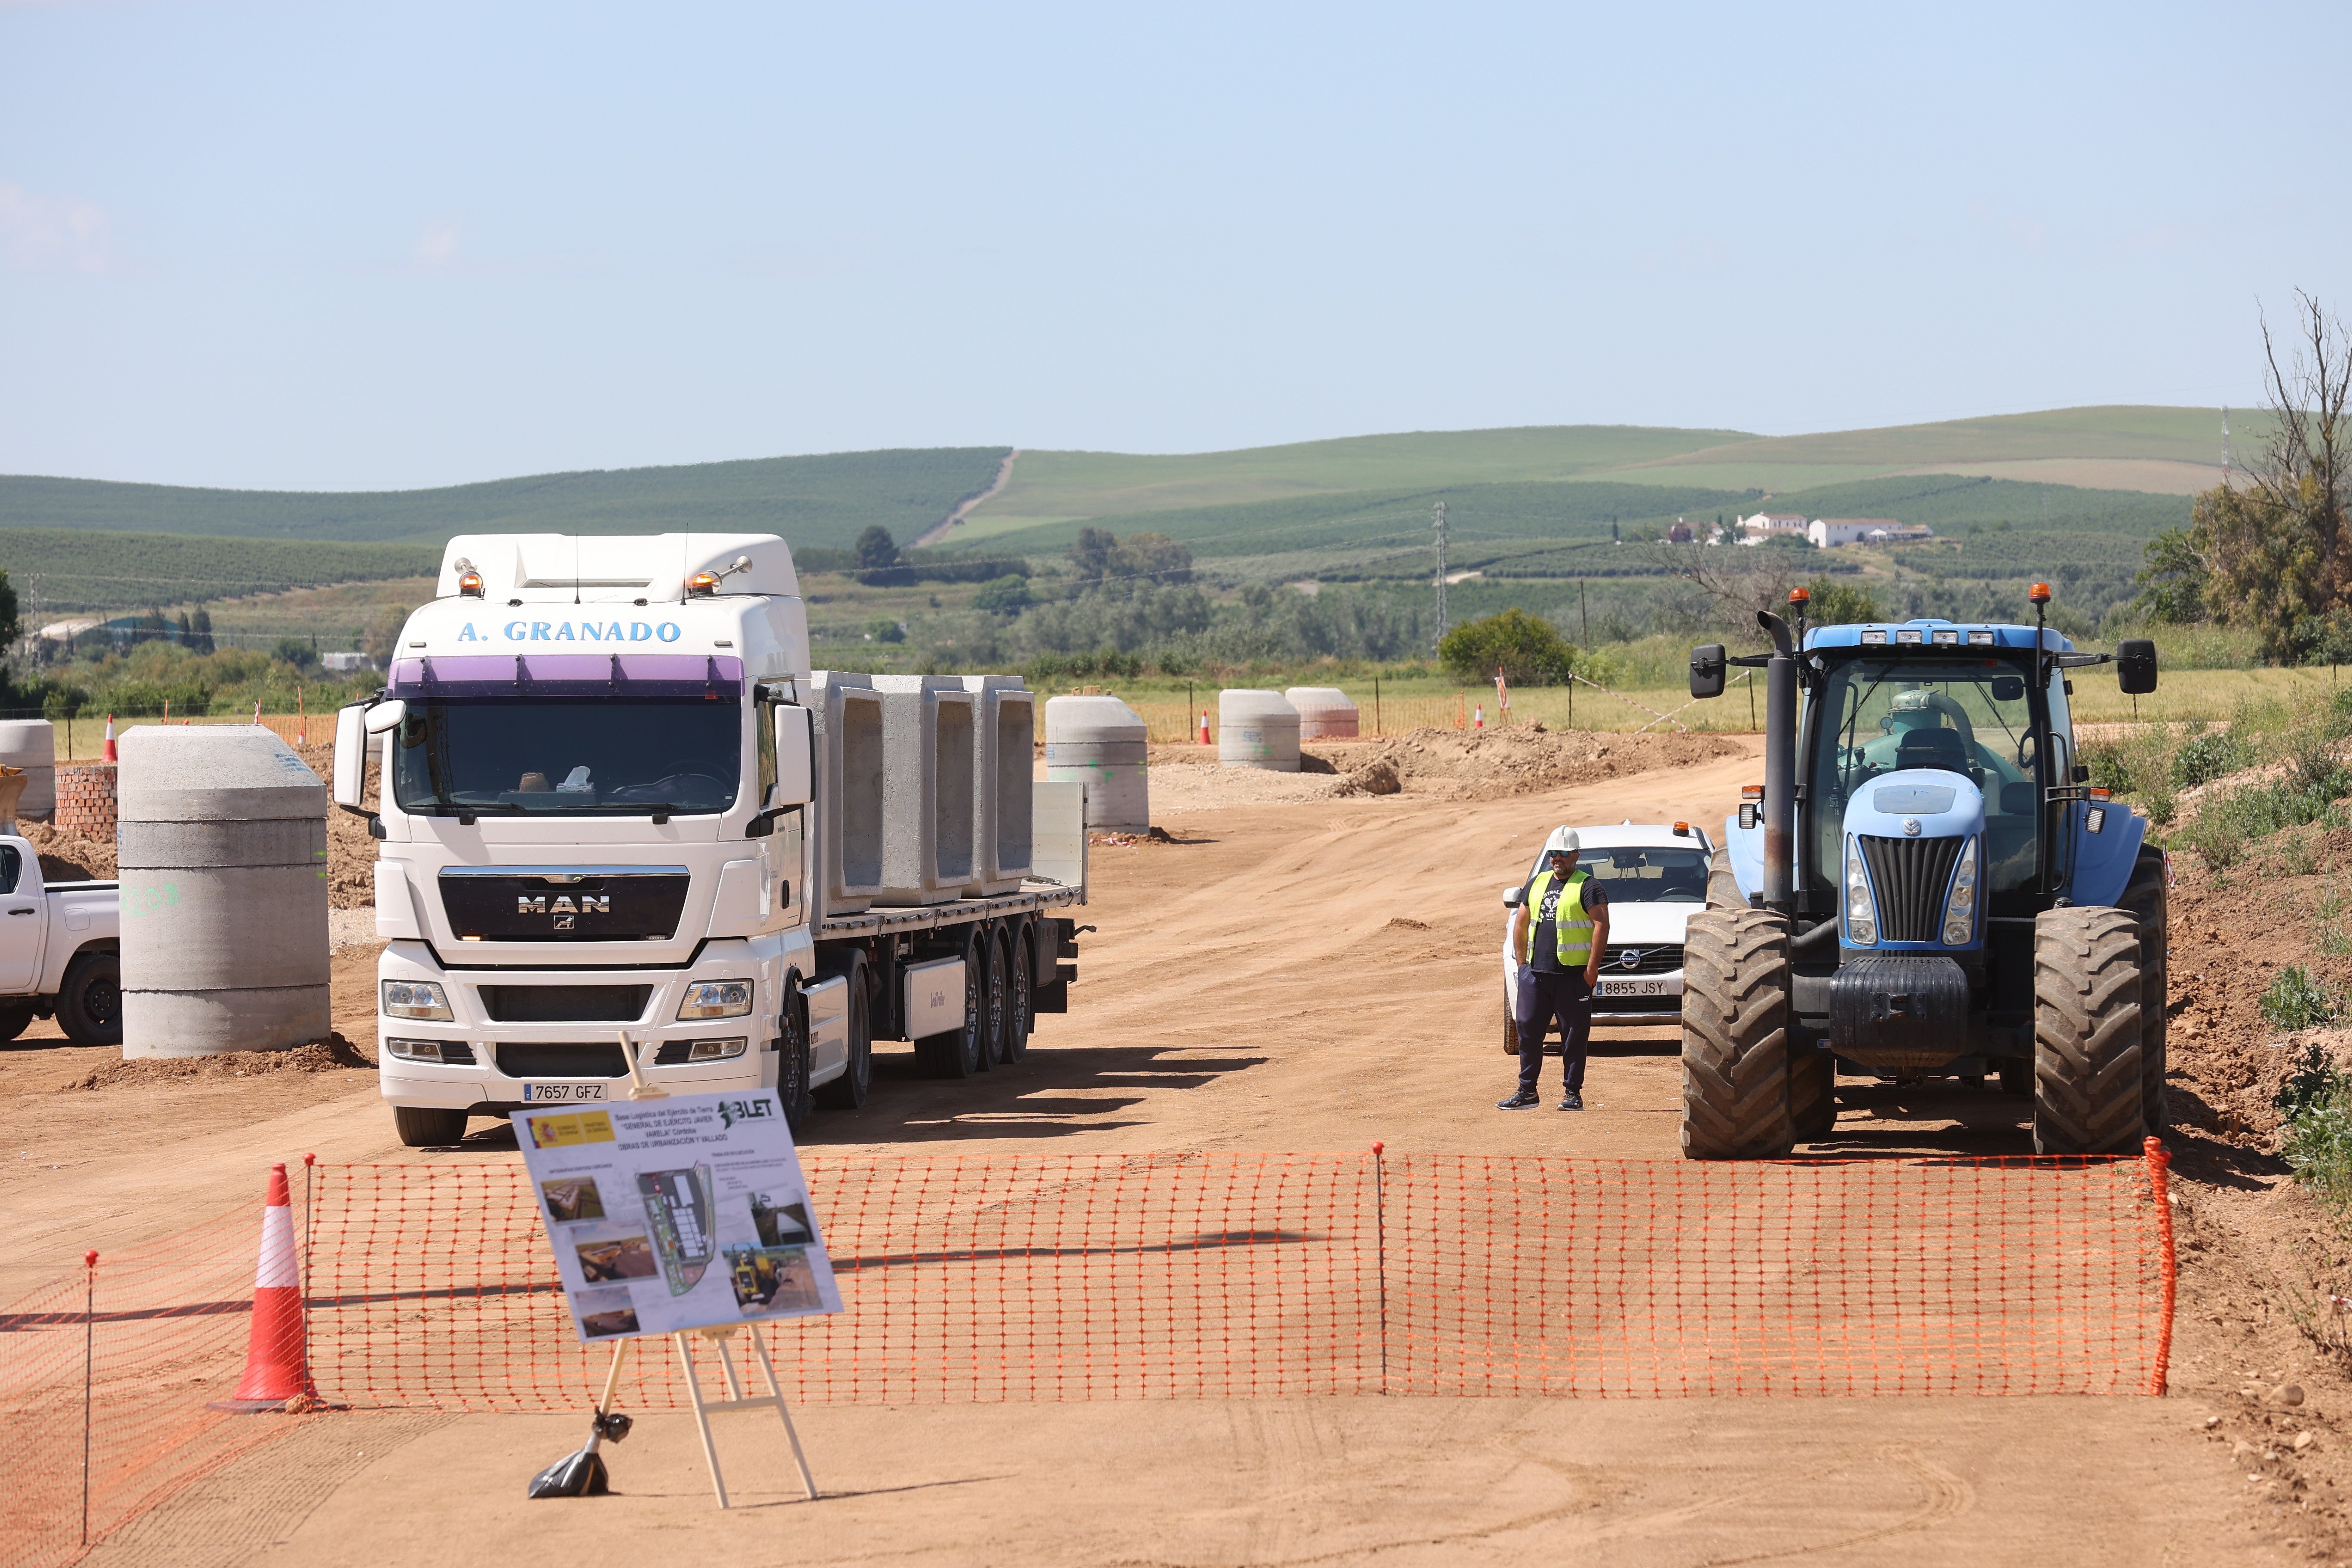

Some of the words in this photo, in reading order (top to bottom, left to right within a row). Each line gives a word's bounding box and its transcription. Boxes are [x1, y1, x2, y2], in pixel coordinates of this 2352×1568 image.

[456, 622, 488, 641] A.
[504, 621, 681, 643] GRANADO
[1543, 890, 1559, 899] NTRAL
[518, 896, 609, 913] MAN
[1605, 983, 1636, 994] 8855
[1641, 982, 1663, 994] JSY
[536, 1086, 570, 1099] 7657
[576, 1085, 602, 1099] GFZ
[618, 1142, 640, 1151] OBRAS
[640, 1141, 649, 1149] DE
[700, 1133, 728, 1143] VALLADO
